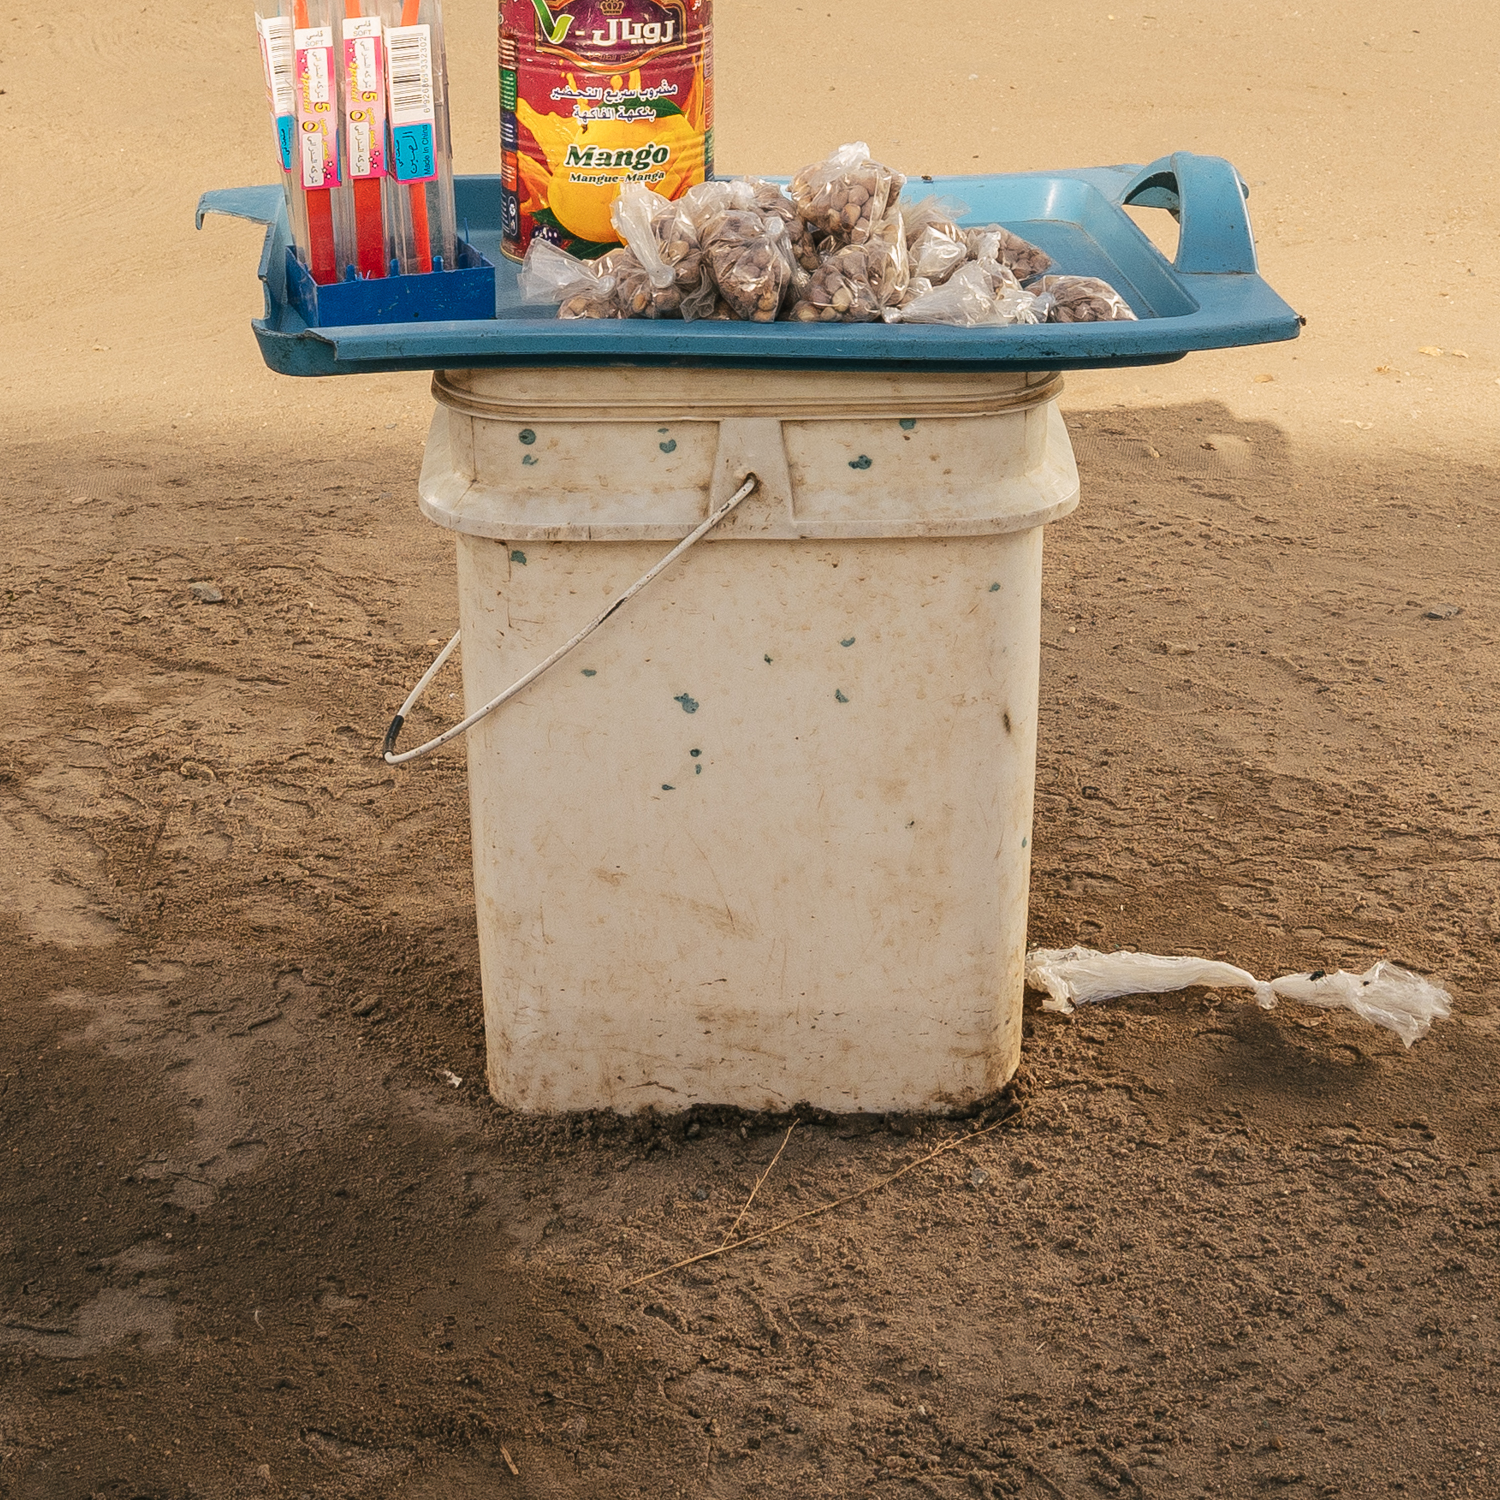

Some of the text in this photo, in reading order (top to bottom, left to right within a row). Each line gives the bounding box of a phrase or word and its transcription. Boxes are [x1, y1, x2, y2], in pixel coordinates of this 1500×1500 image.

[305, 39, 324, 47] SOFT
[353, 29, 372, 37] SOFT
[592, 17, 676, 47] رويال
[300, 72, 331, 114] Special 5
[348, 61, 378, 103] Special 5
[550, 79, 678, 104] مشروب سريع التحضير
[572, 105, 657, 124] بنكهة الفاكهة
[402, 130, 419, 174] الصين
[421, 124, 431, 175] Made In China
[564, 143, 670, 171] Mango
